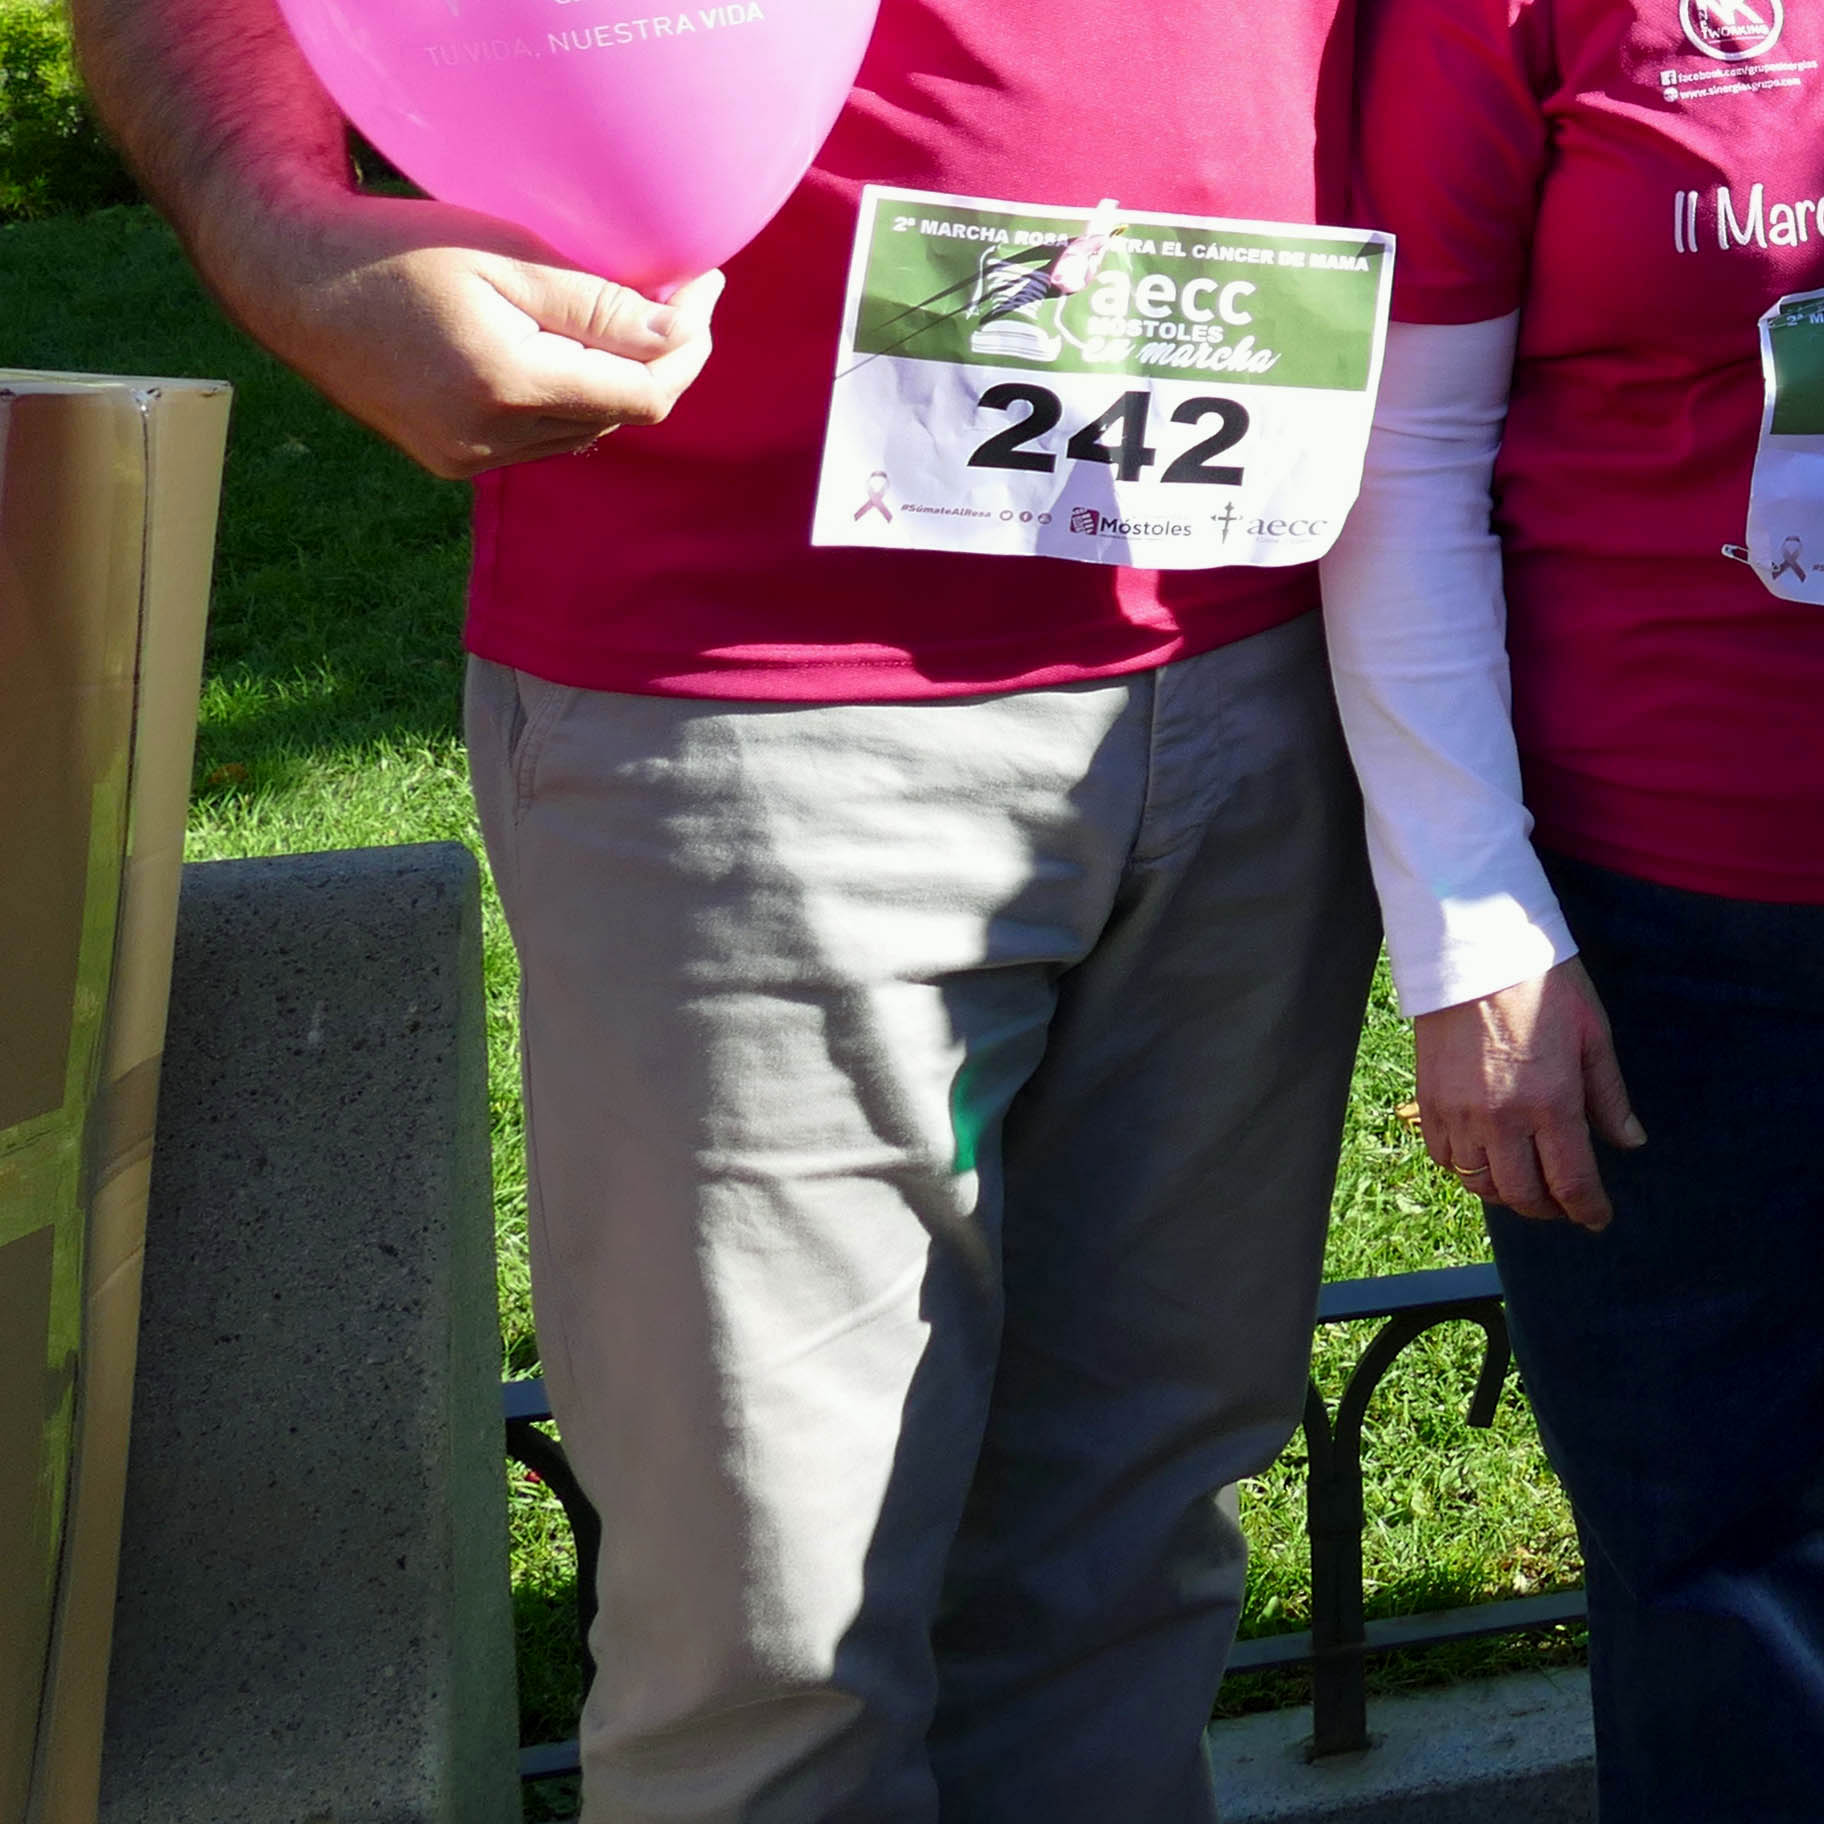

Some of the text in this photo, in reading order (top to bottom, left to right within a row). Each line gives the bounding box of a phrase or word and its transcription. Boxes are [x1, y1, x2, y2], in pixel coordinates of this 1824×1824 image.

[547, 10, 698, 54] NUESTRA
[697, 1, 767, 32] VIDA
[920, 218, 1010, 245] MARCHA
[1014, 229, 1070, 248] ROSA
[1161, 241, 1187, 258] EL
[1191, 242, 1275, 266] CÁNCER
[1278, 250, 1306, 269] DE
[1308, 254, 1370, 272] MAMA
[1090, 268, 1257, 326] aecc
[1136, 334, 1283, 374] marcha
[965, 381, 1252, 487] 242
[1100, 515, 1193, 539] Móstoles
[1245, 515, 1329, 538] aecc
